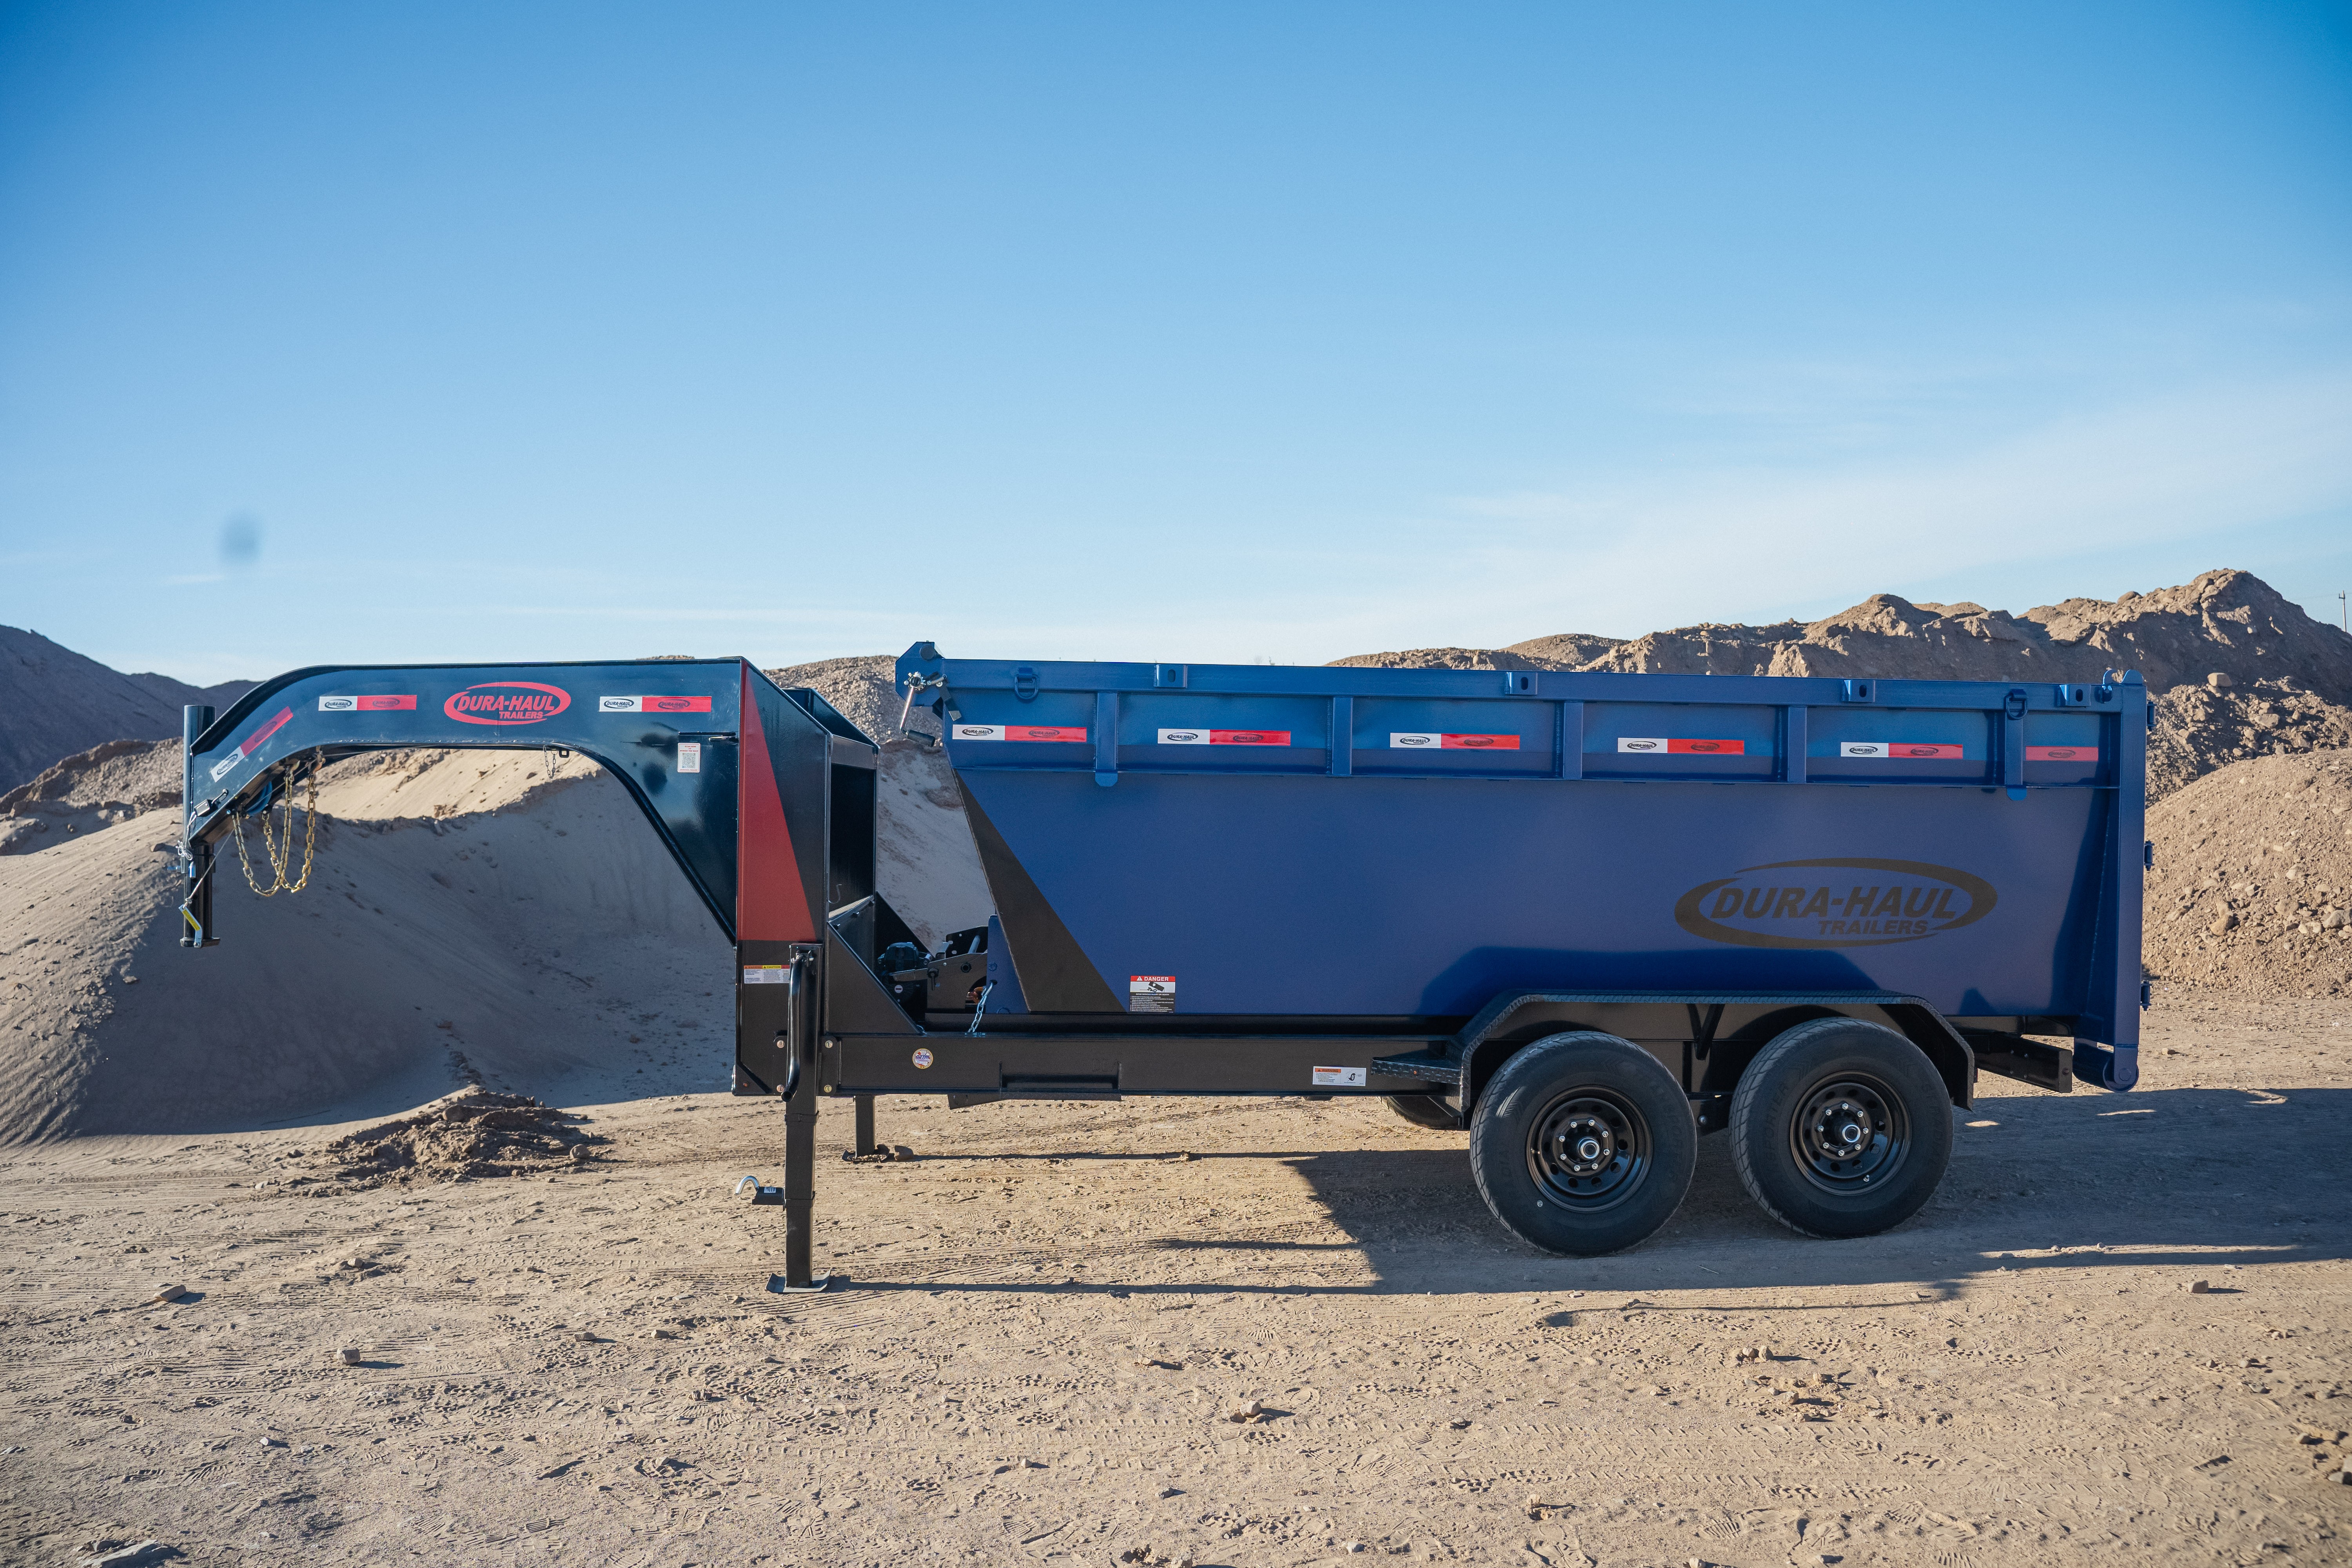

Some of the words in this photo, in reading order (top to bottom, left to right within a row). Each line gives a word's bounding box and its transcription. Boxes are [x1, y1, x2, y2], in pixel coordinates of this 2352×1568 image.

[457, 695, 555, 711] DURA-HAUL
[219, 757, 236, 773] DURA-HAUL
[1710, 887, 1956, 919] DURA-HAUL
[1818, 920, 1928, 935] TRAILERS
